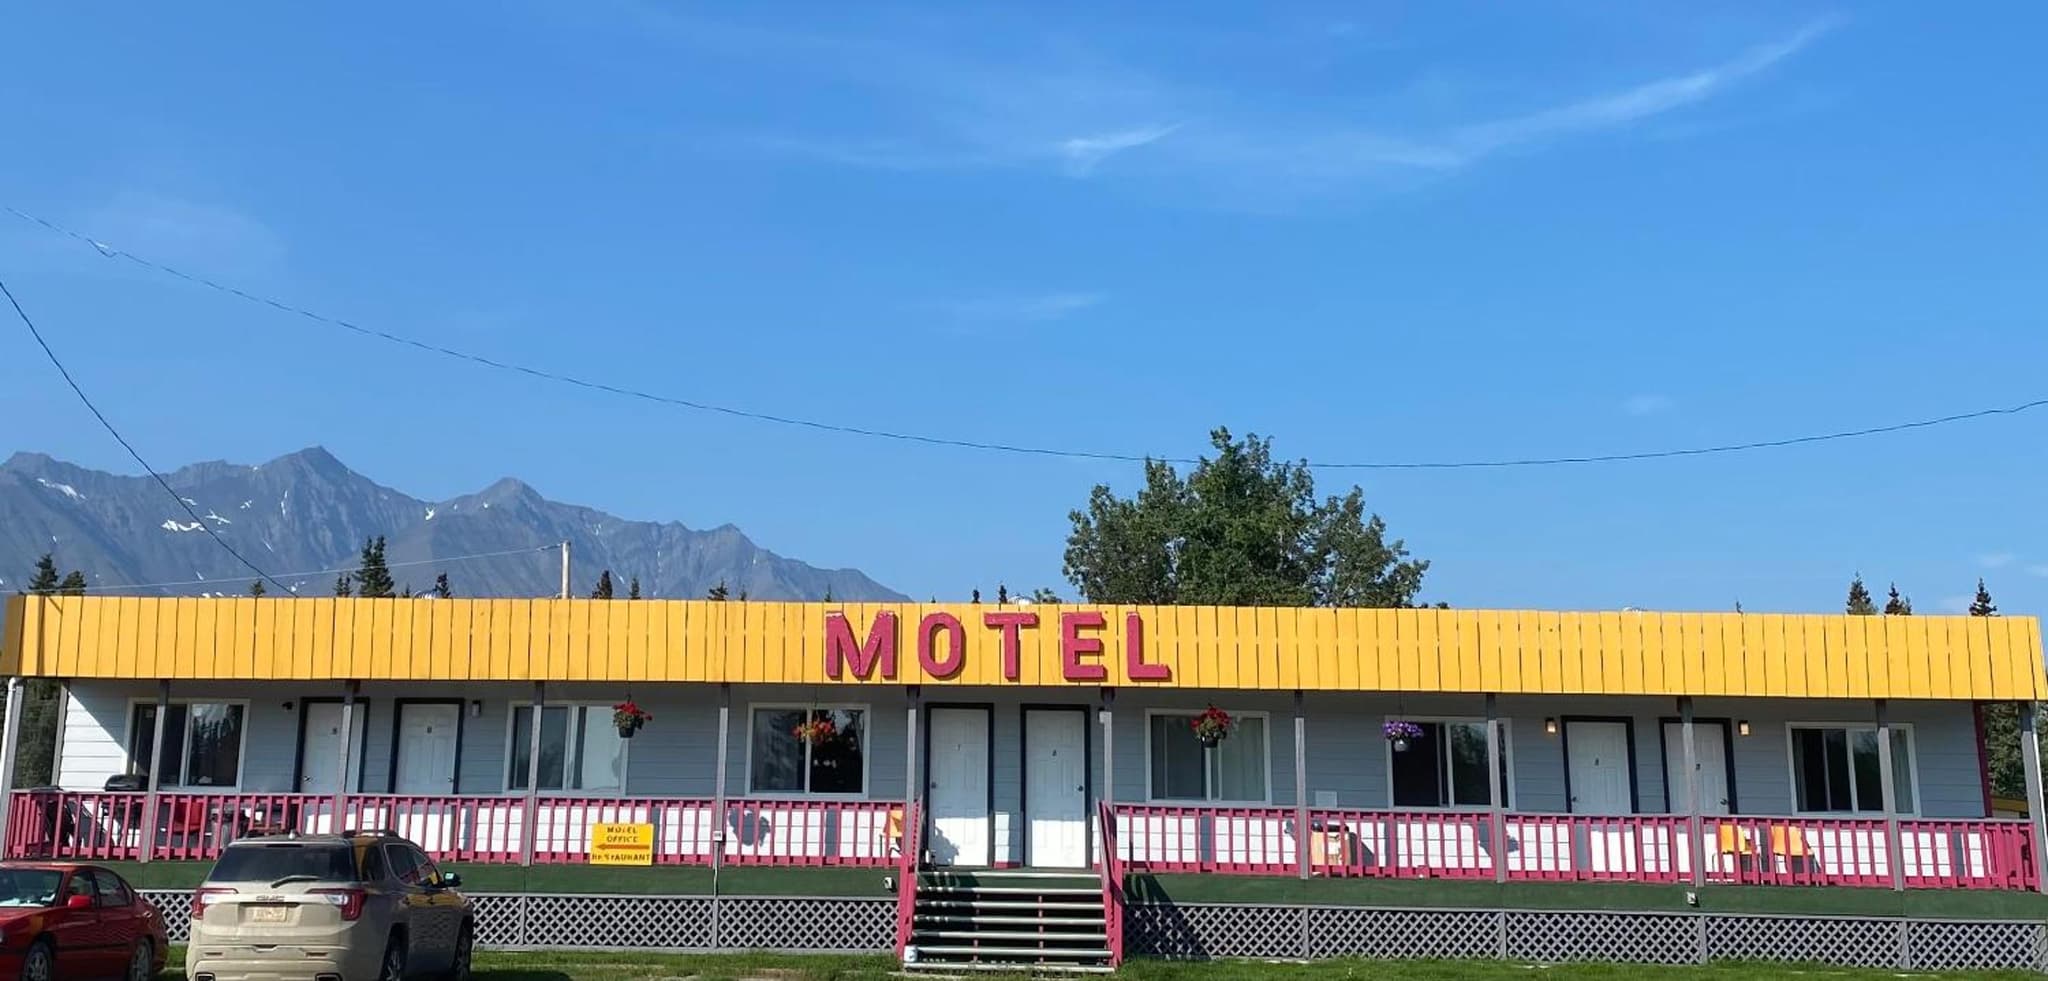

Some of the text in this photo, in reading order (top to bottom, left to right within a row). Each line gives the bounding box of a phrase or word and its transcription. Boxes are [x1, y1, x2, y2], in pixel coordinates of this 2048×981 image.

[824, 610, 1172, 683] MOTEL
[606, 826, 639, 834] MOTEL
[606, 835, 640, 843] OFFICE
[592, 853, 650, 862] RESTAURANT
